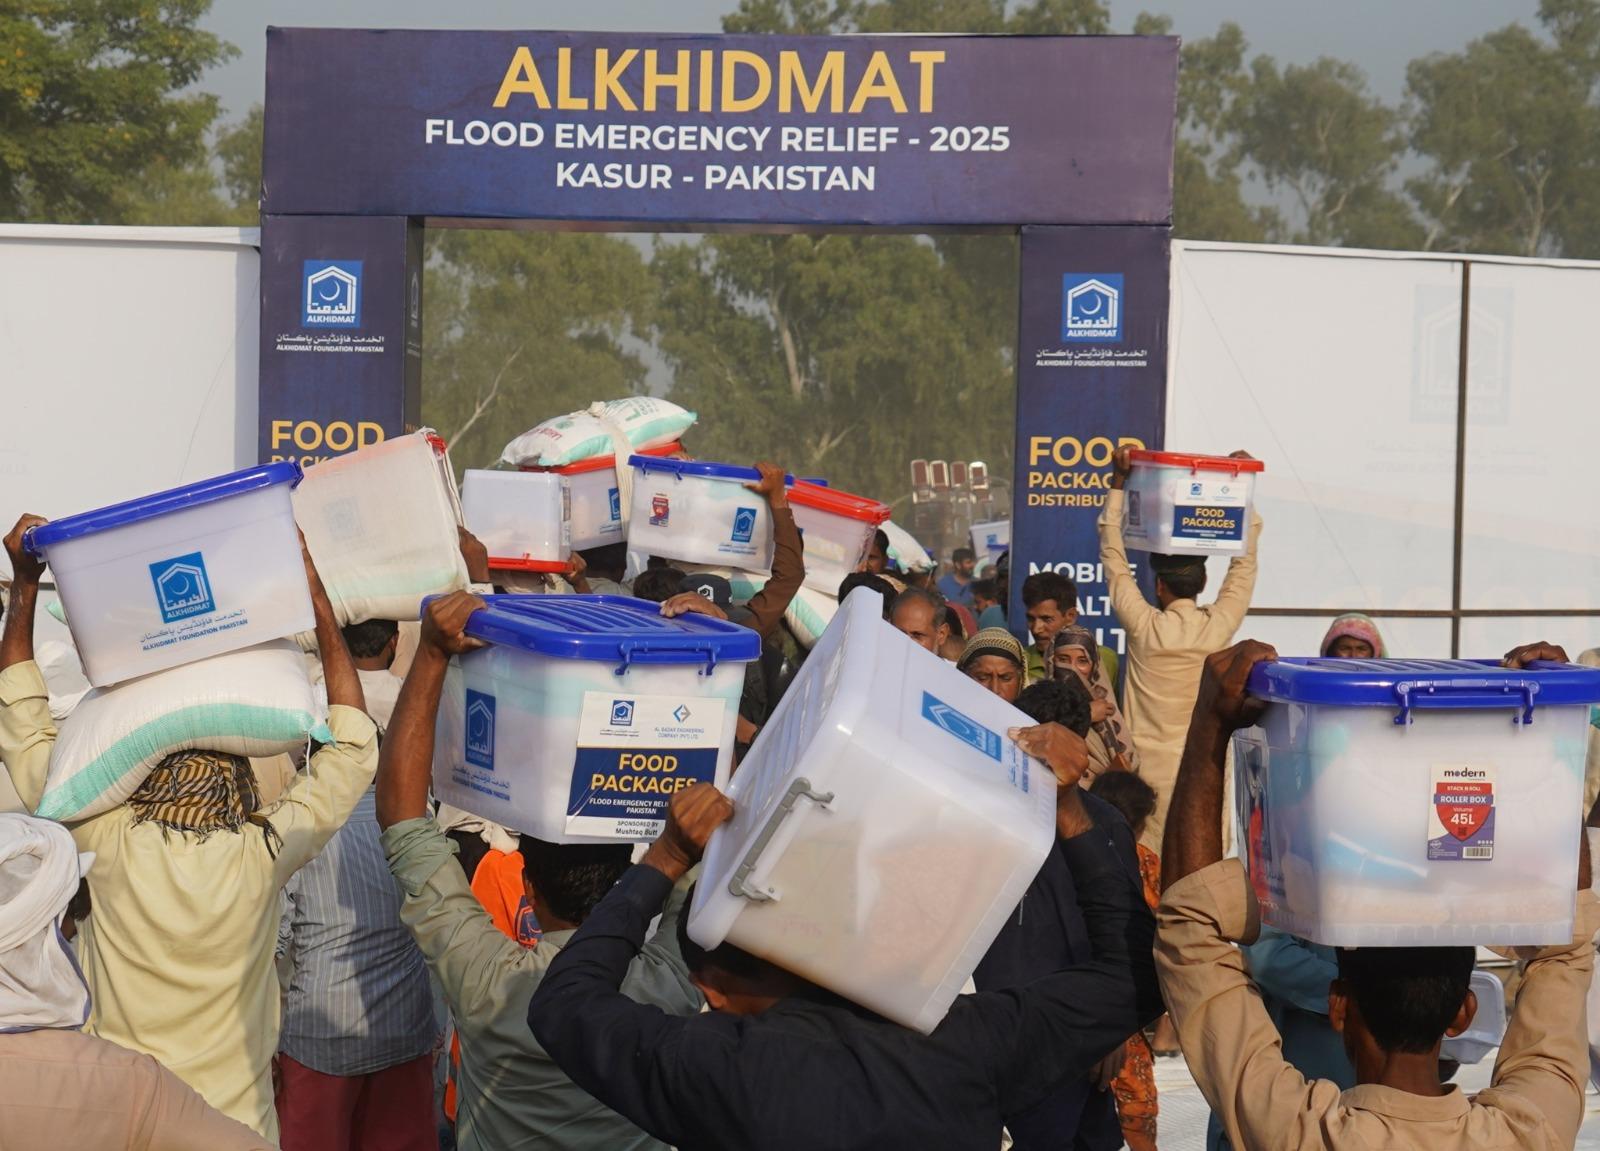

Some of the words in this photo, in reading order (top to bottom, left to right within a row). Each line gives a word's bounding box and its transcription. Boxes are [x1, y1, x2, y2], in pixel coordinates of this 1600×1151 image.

[492, 46, 947, 114] ALKHIDMAT
[425, 118, 545, 148] FLOOD
[555, 123, 772, 153] EMERGENCY
[781, 126, 899, 152] RELIEF
[929, 126, 1010, 152] 2025
[556, 162, 673, 189] KASUR
[704, 165, 876, 191] PAKISTAN
[307, 315, 355, 323] ALKHIDMAT
[1067, 329, 1117, 337] ALKHIDMAT
[271, 420, 385, 451] FOOD
[1195, 507, 1225, 518] FOOD
[1182, 517, 1235, 529] PACKAGES
[166, 602, 211, 618] ALKHIDMAT
[143, 638, 178, 650] ALKHIDMAT
[179, 627, 218, 641] FOUNDATION
[219, 619, 248, 631] PAKISTAN
[619, 754, 678, 773] FOOD
[1444, 766, 1486, 778] modern
[589, 797, 612, 806] FLOOD
[612, 799, 653, 808] EMERGENCY
[1440, 795, 1469, 804] ROLLER
[1470, 795, 1487, 804] BOX
[626, 807, 657, 815] PAKISTAN
[617, 820, 651, 828] SPONSORED
[1451, 813, 1475, 825] 45L
[615, 828, 643, 837] Mushtaq
